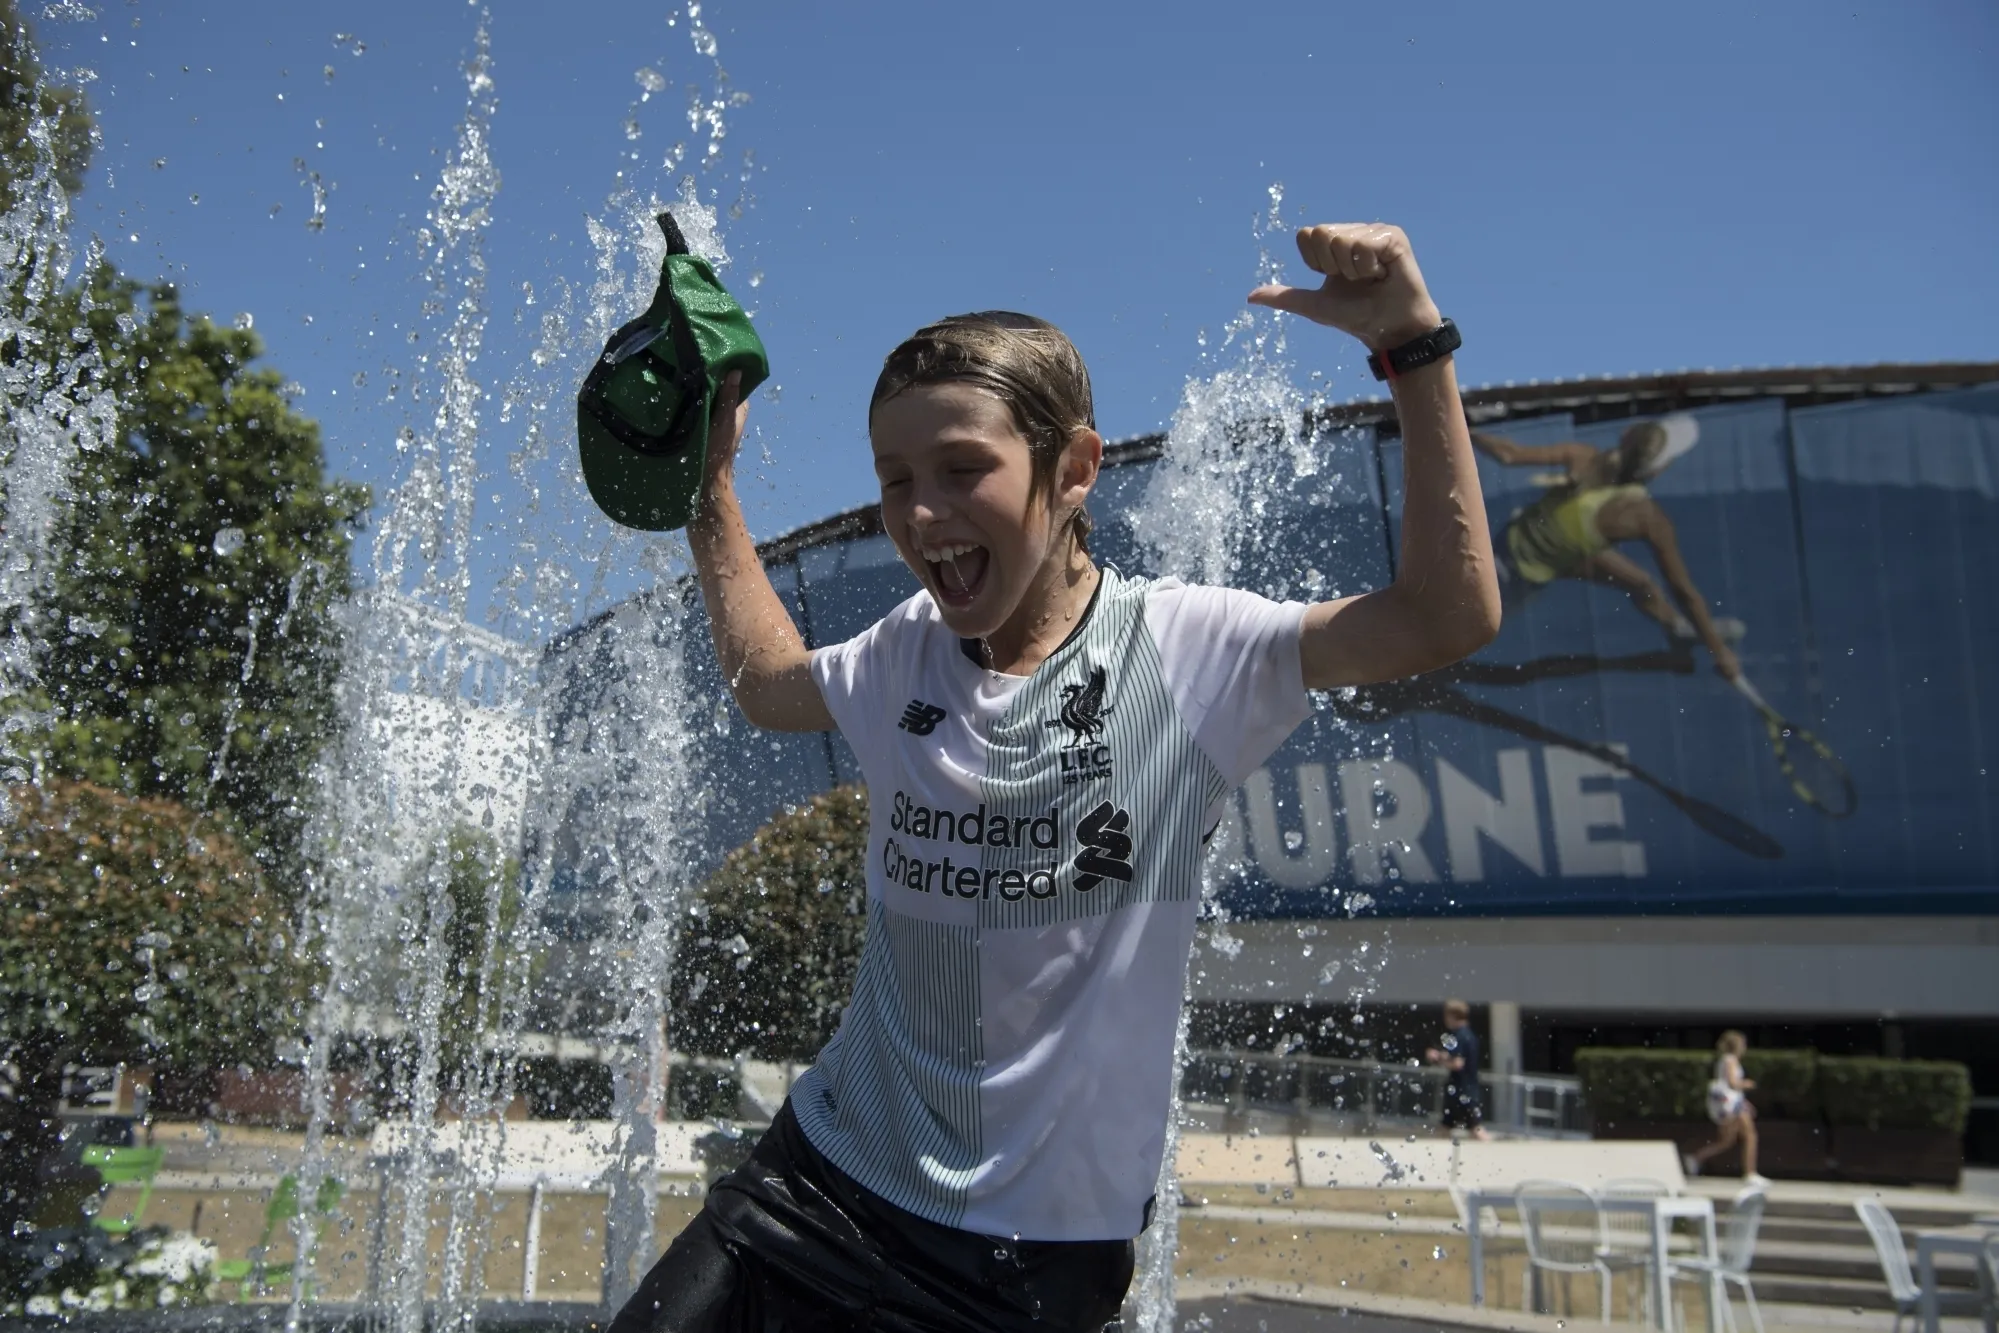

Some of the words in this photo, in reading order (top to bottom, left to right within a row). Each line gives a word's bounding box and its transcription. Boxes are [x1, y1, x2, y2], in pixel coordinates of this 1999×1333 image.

[1080, 768, 1112, 782] YEARS
[890, 790, 1059, 849] Standard
[883, 837, 1058, 901] Chartered
